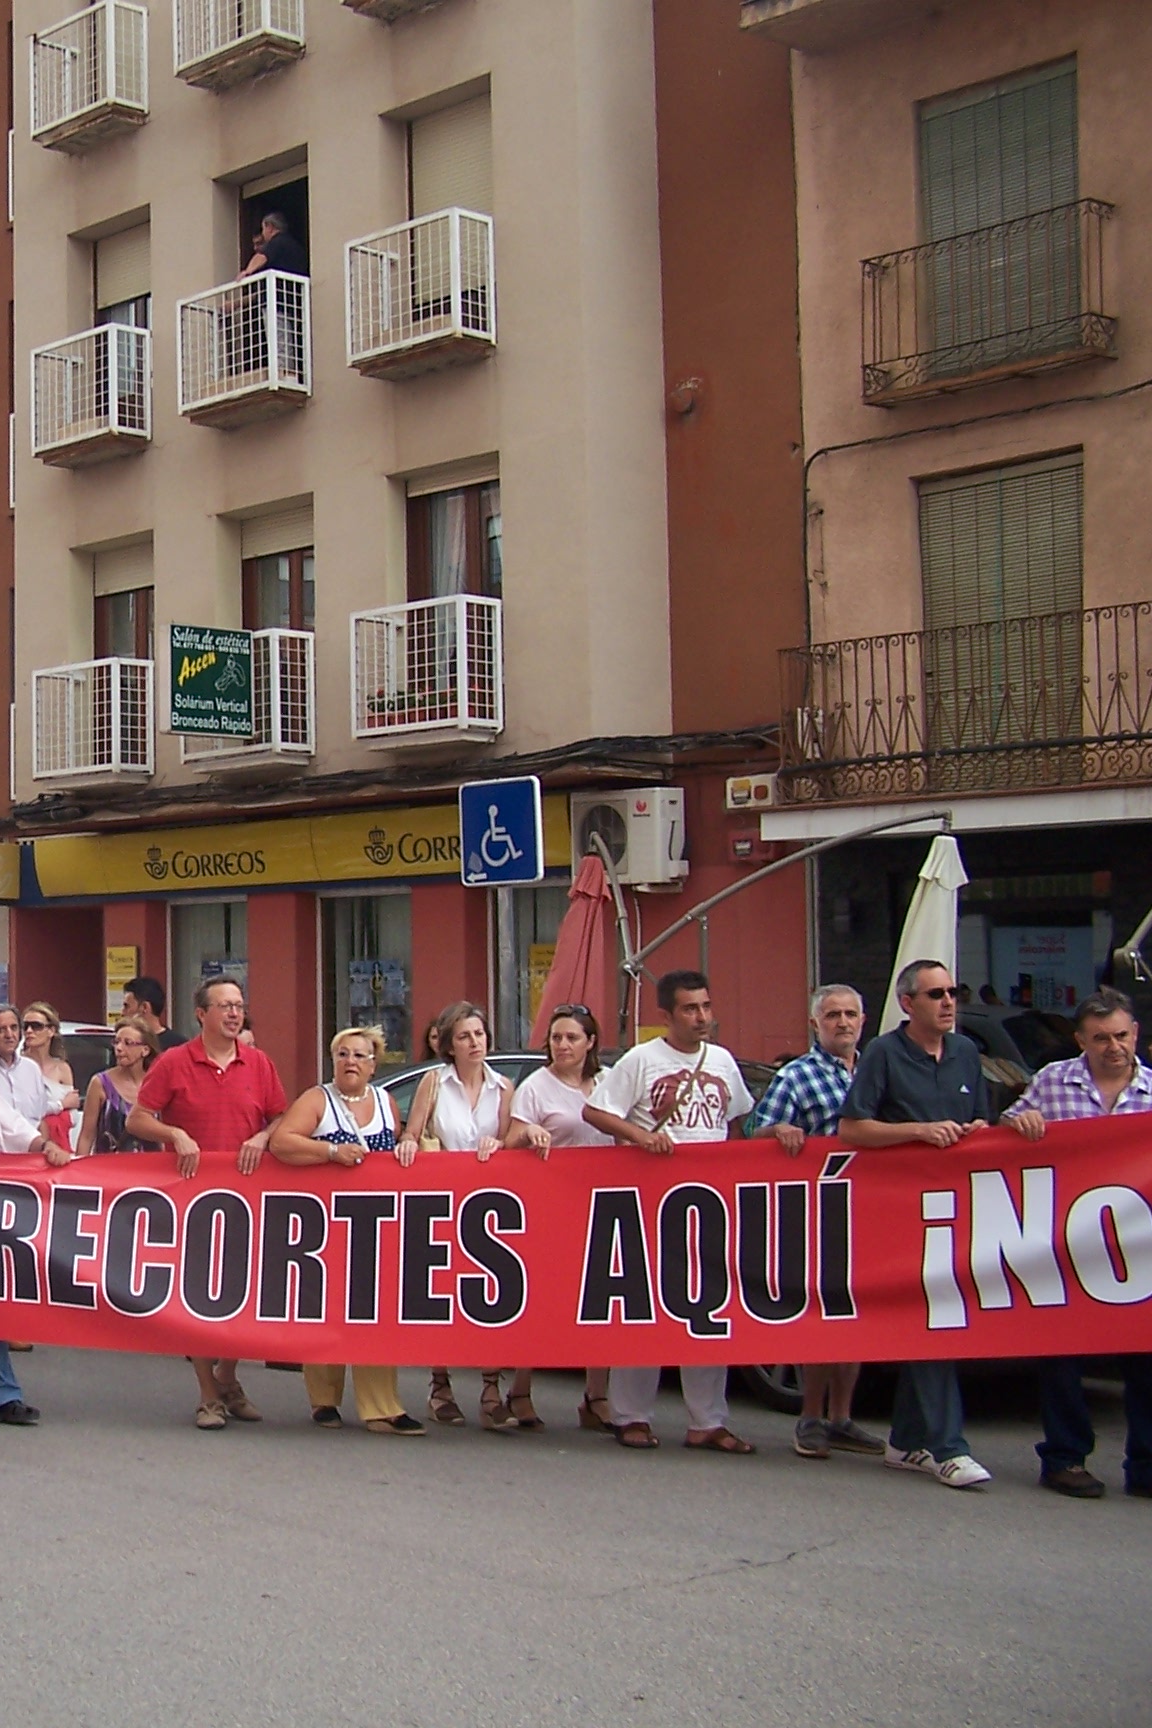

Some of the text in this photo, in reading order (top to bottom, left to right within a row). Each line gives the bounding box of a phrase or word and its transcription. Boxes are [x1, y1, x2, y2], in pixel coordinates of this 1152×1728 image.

[173, 627, 249, 648] Salón de estética
[178, 652, 216, 687] Ascen
[215, 697, 248, 713] Vertical
[172, 712, 219, 730] Bronceado
[398, 833, 460, 864] CORR
[172, 850, 266, 878] CORREOS
[575, 1151, 857, 1339] AQUÍ
